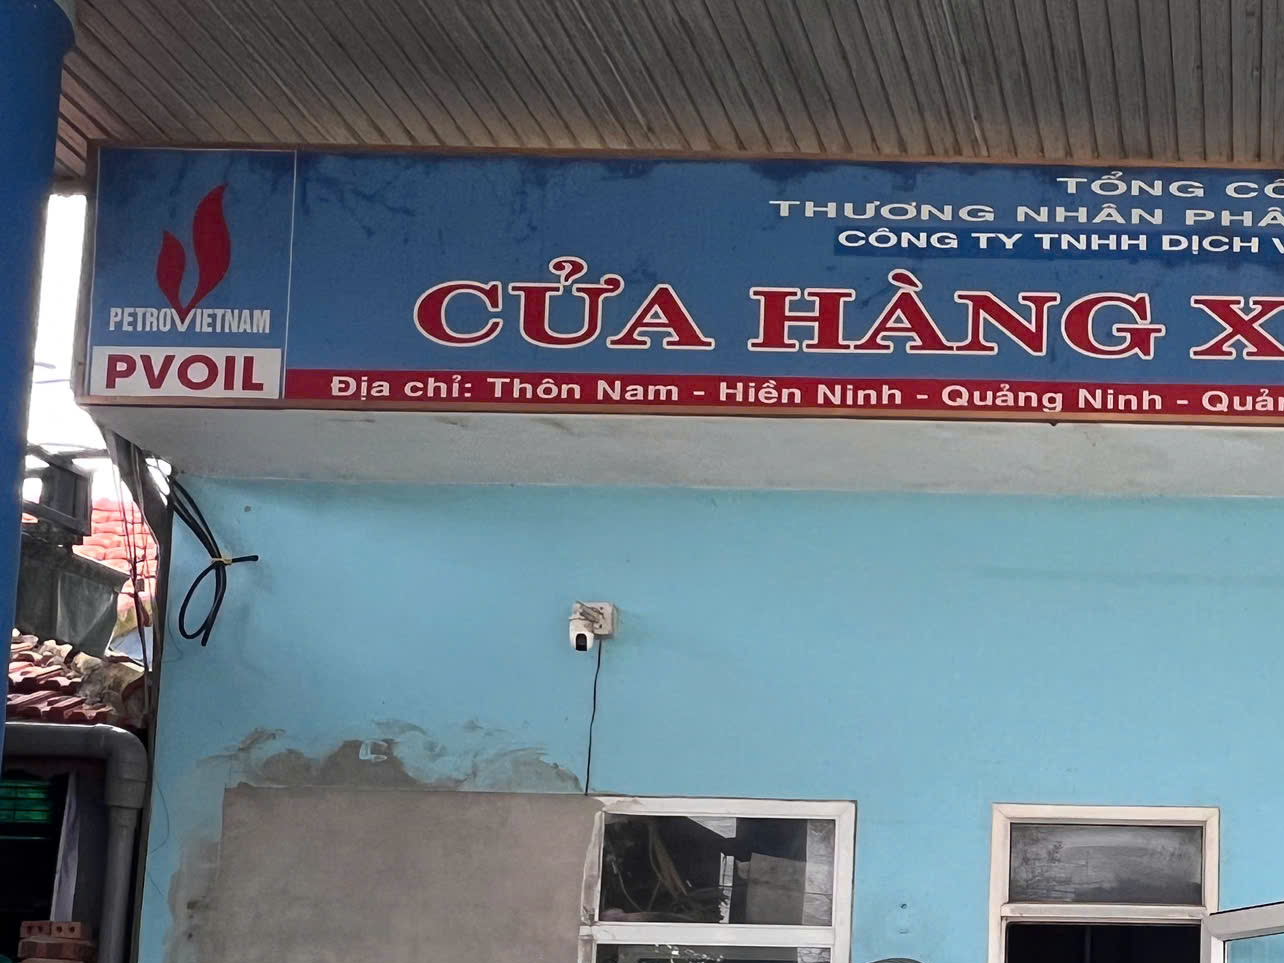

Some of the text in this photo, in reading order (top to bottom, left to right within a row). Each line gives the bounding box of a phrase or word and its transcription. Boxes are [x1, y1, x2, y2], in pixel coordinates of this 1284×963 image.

[1057, 171, 1203, 197] TỔNG
[769, 201, 994, 221] THƯƠNG
[1017, 203, 1162, 224] NHÂN
[839, 228, 957, 248] CÔNG
[972, 233, 1022, 248] TY
[1035, 234, 1146, 250] TNHH
[1162, 235, 1258, 254] DỊCH
[109, 308, 270, 333] PETROVIETNAM
[413, 256, 715, 350] CỬA
[748, 269, 1166, 360] HÀNG
[104, 353, 264, 392] PVOIL
[331, 377, 389, 400] Địa
[405, 375, 471, 397] chỉ:
[487, 378, 580, 398] Thôn
[598, 380, 678, 400] Nam
[720, 380, 800, 403] Hiền
[818, 385, 901, 405] Ninh
[942, 384, 1062, 412] Quảng
[1078, 389, 1162, 411] Ninh
